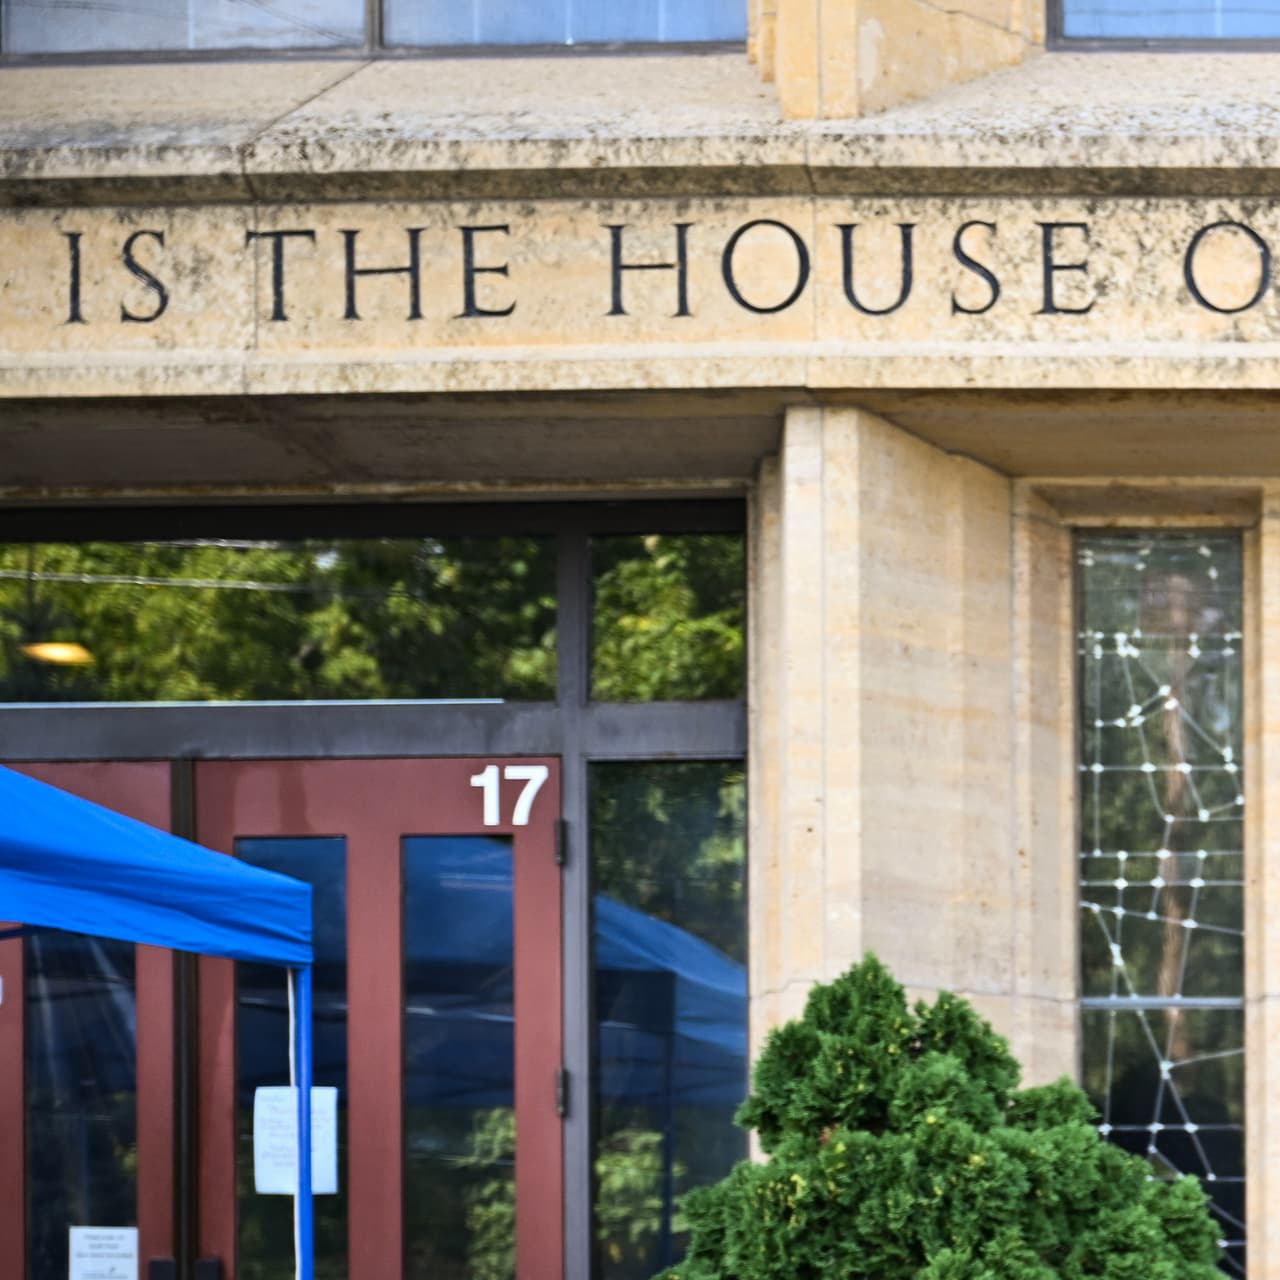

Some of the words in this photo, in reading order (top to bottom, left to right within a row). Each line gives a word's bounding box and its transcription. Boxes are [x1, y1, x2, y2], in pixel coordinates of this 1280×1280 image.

[60, 228, 171, 325] IS
[245, 223, 518, 323] THE
[602, 218, 1097, 320] HOUSE
[469, 763, 549, 827] 17
